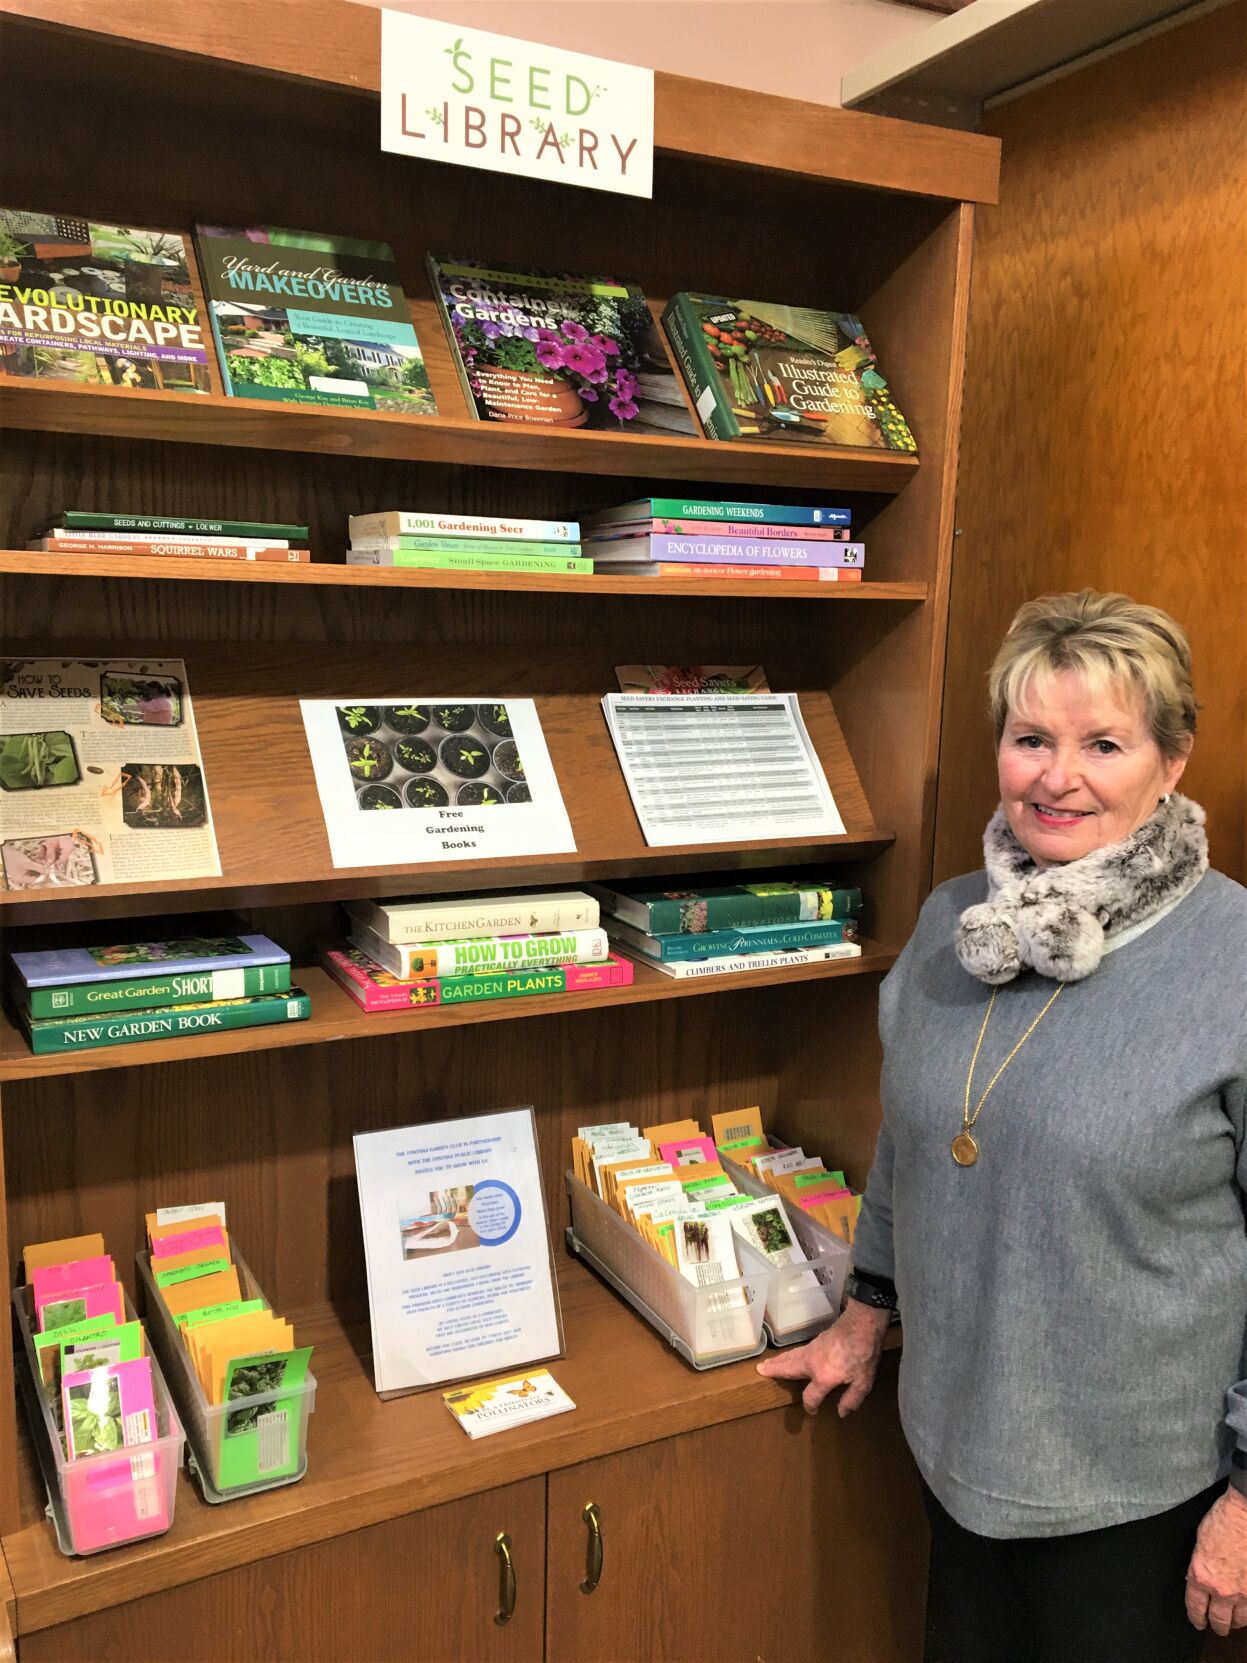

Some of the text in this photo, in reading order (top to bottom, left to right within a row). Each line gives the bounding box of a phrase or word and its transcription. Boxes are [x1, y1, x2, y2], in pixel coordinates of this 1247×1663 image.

[444, 40, 592, 117] SEED
[401, 93, 638, 176] LIBRARY
[221, 256, 389, 291] Yard and Garden
[228, 269, 393, 308] MAKEOVERS
[0, 284, 197, 325] EVOLUTIONARY
[450, 284, 569, 312] Container
[455, 303, 558, 330] Gardens
[710, 312, 737, 324] UPDATED
[0, 302, 205, 349] ARDSCAPE
[26, 337, 77, 349] CONTAINERS,
[78, 343, 121, 355] PATHWAYS,
[122, 348, 160, 359] LIGHTING,
[161, 353, 176, 361] AND
[80, 338, 102, 346] LOCAL
[105, 341, 148, 352] MATERIALS
[667, 312, 686, 358] Illustrated
[685, 356, 697, 387] Guide
[695, 384, 702, 398] to
[476, 371, 517, 381] Everything
[535, 377, 554, 385] Need
[777, 363, 859, 385] Illustrated
[481, 385, 502, 393] Plant,
[483, 392, 520, 402] Beautiful,
[792, 380, 860, 400] Guide to
[485, 400, 533, 410] Maintenance
[790, 394, 876, 419] Gardening
[525, 415, 554, 423] Bowman
[682, 505, 764, 518] GARDENING WEEKENDS
[114, 518, 222, 531] SEEDS AND CUTTINGS LOEWER
[438, 520, 497, 534] Gardening
[500, 524, 524, 534] Secr
[728, 525, 765, 536] Beautiful
[767, 527, 798, 537] Borders
[150, 544, 205, 556] SQUIRREL
[207, 547, 238, 557] WARS
[667, 542, 808, 559] ENCYCLOPEDIA OF FLOWERS
[502, 560, 556, 568] GARDENING
[17, 674, 61, 684] HOW TO
[673, 676, 737, 687] Seed Savers
[7, 685, 91, 699] SAVE SEEDS
[439, 810, 463, 819] Free
[426, 823, 484, 834] Gardening
[442, 839, 477, 850] Books
[405, 925, 422, 934] THE
[455, 937, 577, 964] HOW TO GROW
[692, 942, 730, 953] GROWING
[730, 936, 778, 951] PERENNIALS
[455, 954, 578, 974] PRACTICALLY EVERYTHING
[686, 955, 808, 976] CLIMBERS AND TRELLIS PLANTS
[87, 986, 122, 1001] Great
[125, 985, 170, 998] Garden
[442, 982, 503, 998] GARDEN
[507, 976, 563, 992] PLANTS
[63, 1013, 222, 1044] NEW GARDEN BOOK
[70, 1330, 107, 1343] CILANTRO
[477, 1397, 551, 1420] POLLINATORS
